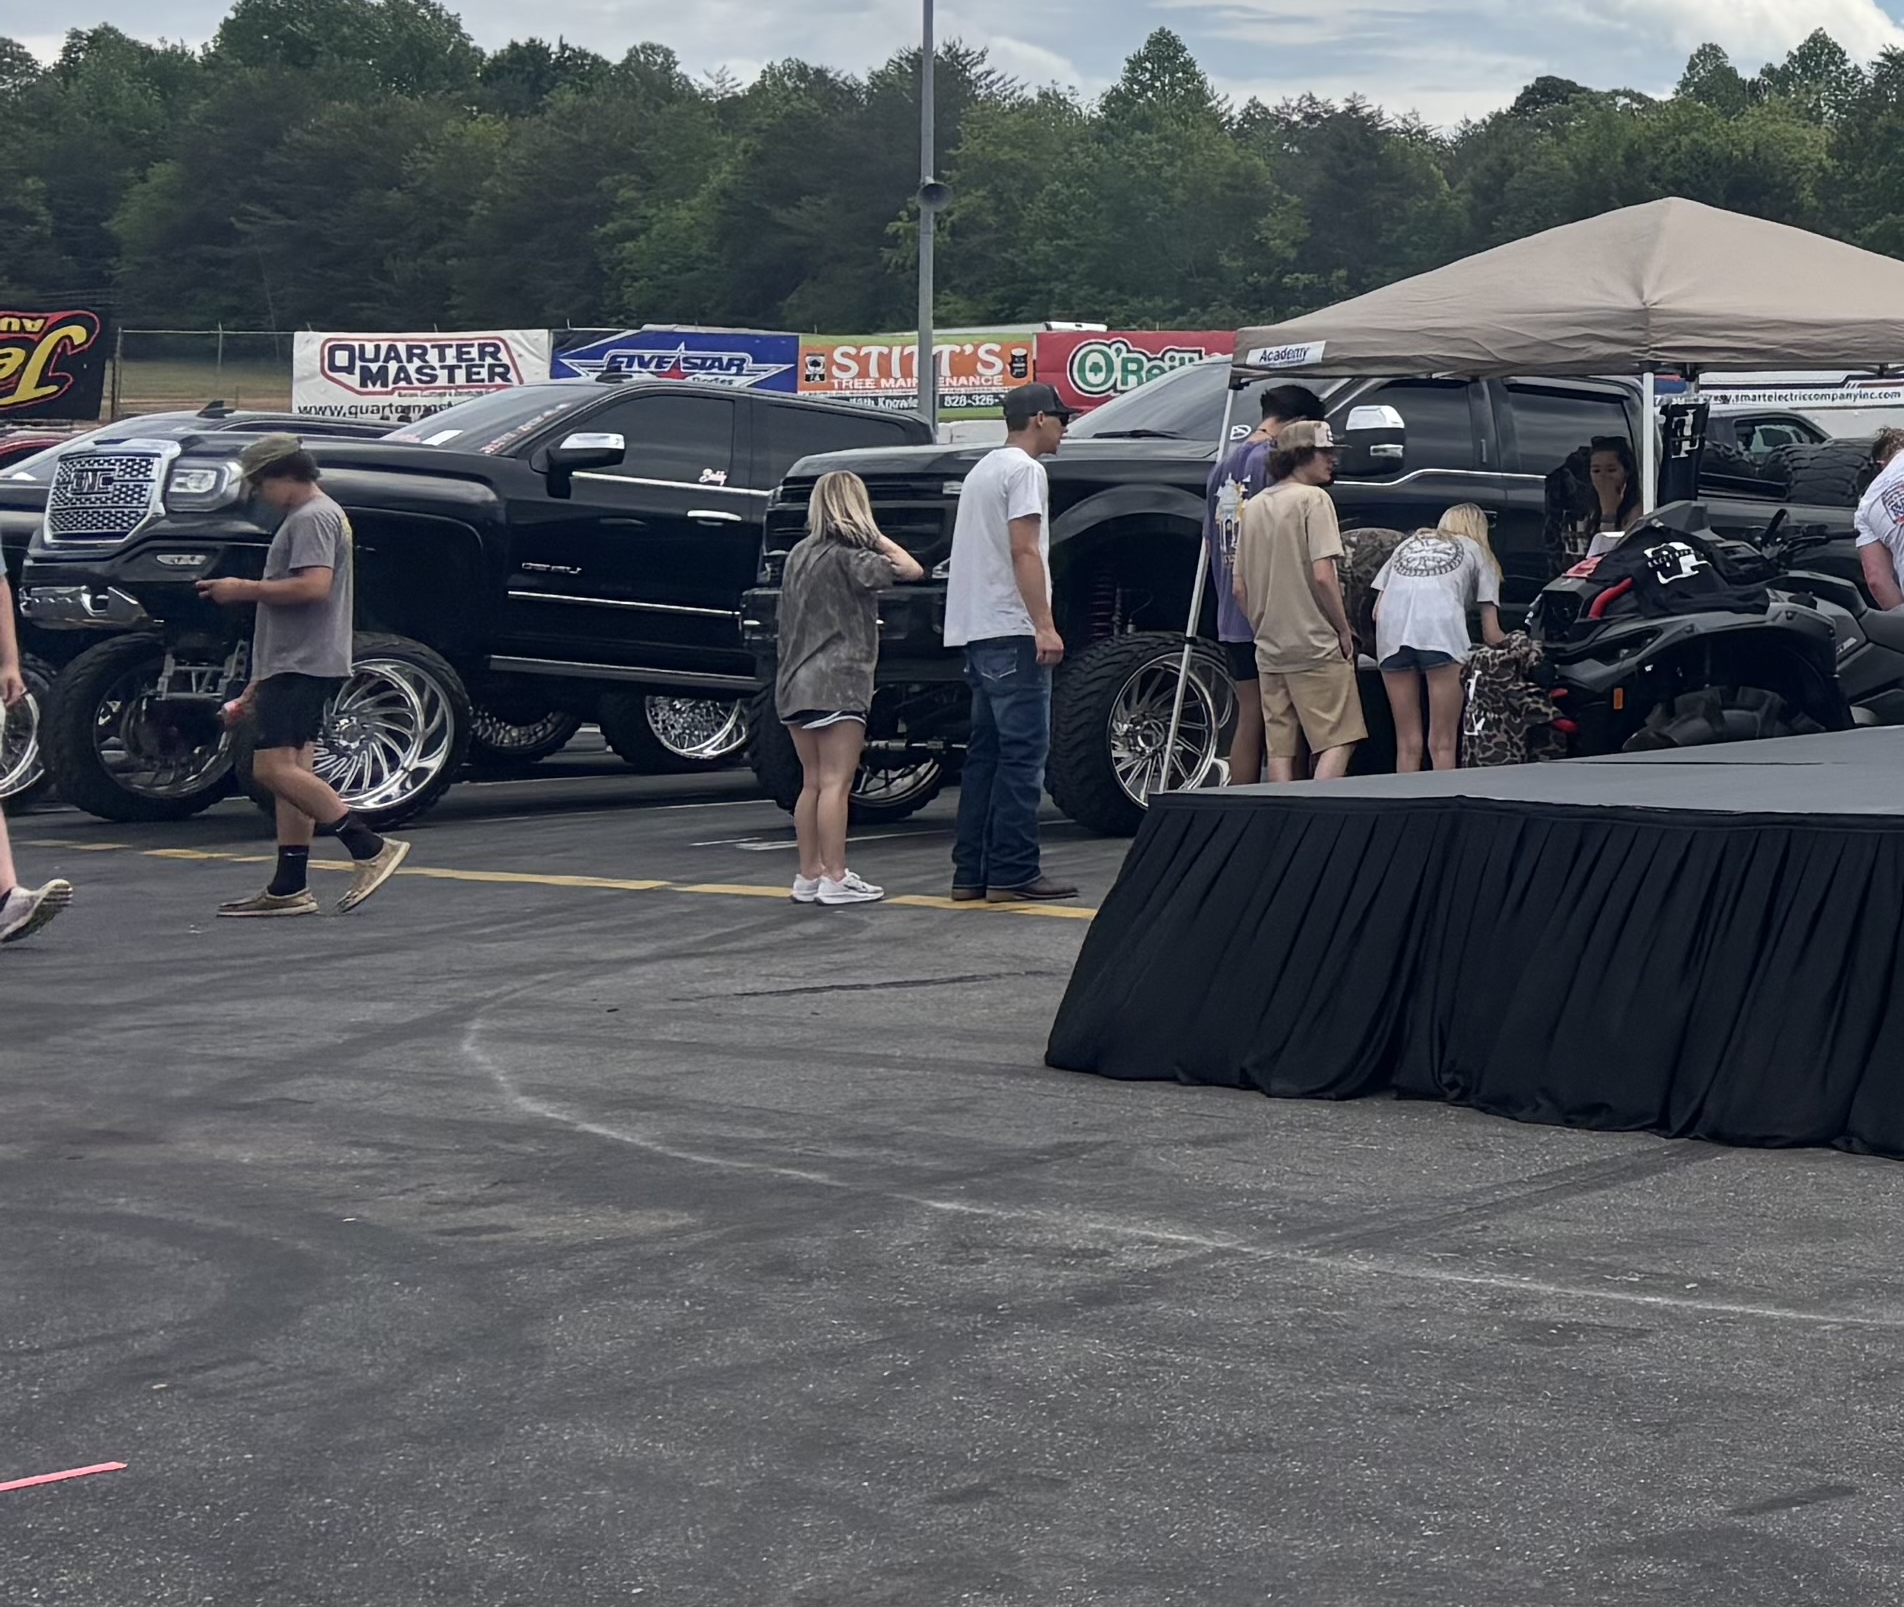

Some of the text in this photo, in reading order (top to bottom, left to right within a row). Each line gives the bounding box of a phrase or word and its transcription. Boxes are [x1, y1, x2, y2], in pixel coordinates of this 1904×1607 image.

[327, 342, 503, 376] QUARTER
[608, 354, 748, 375] FIVE STAR
[1259, 347, 1311, 362] Academy
[358, 363, 514, 389] MASTER
[1076, 346, 1196, 388] O'Re
[831, 375, 1004, 390] TREE MAINENANCE
